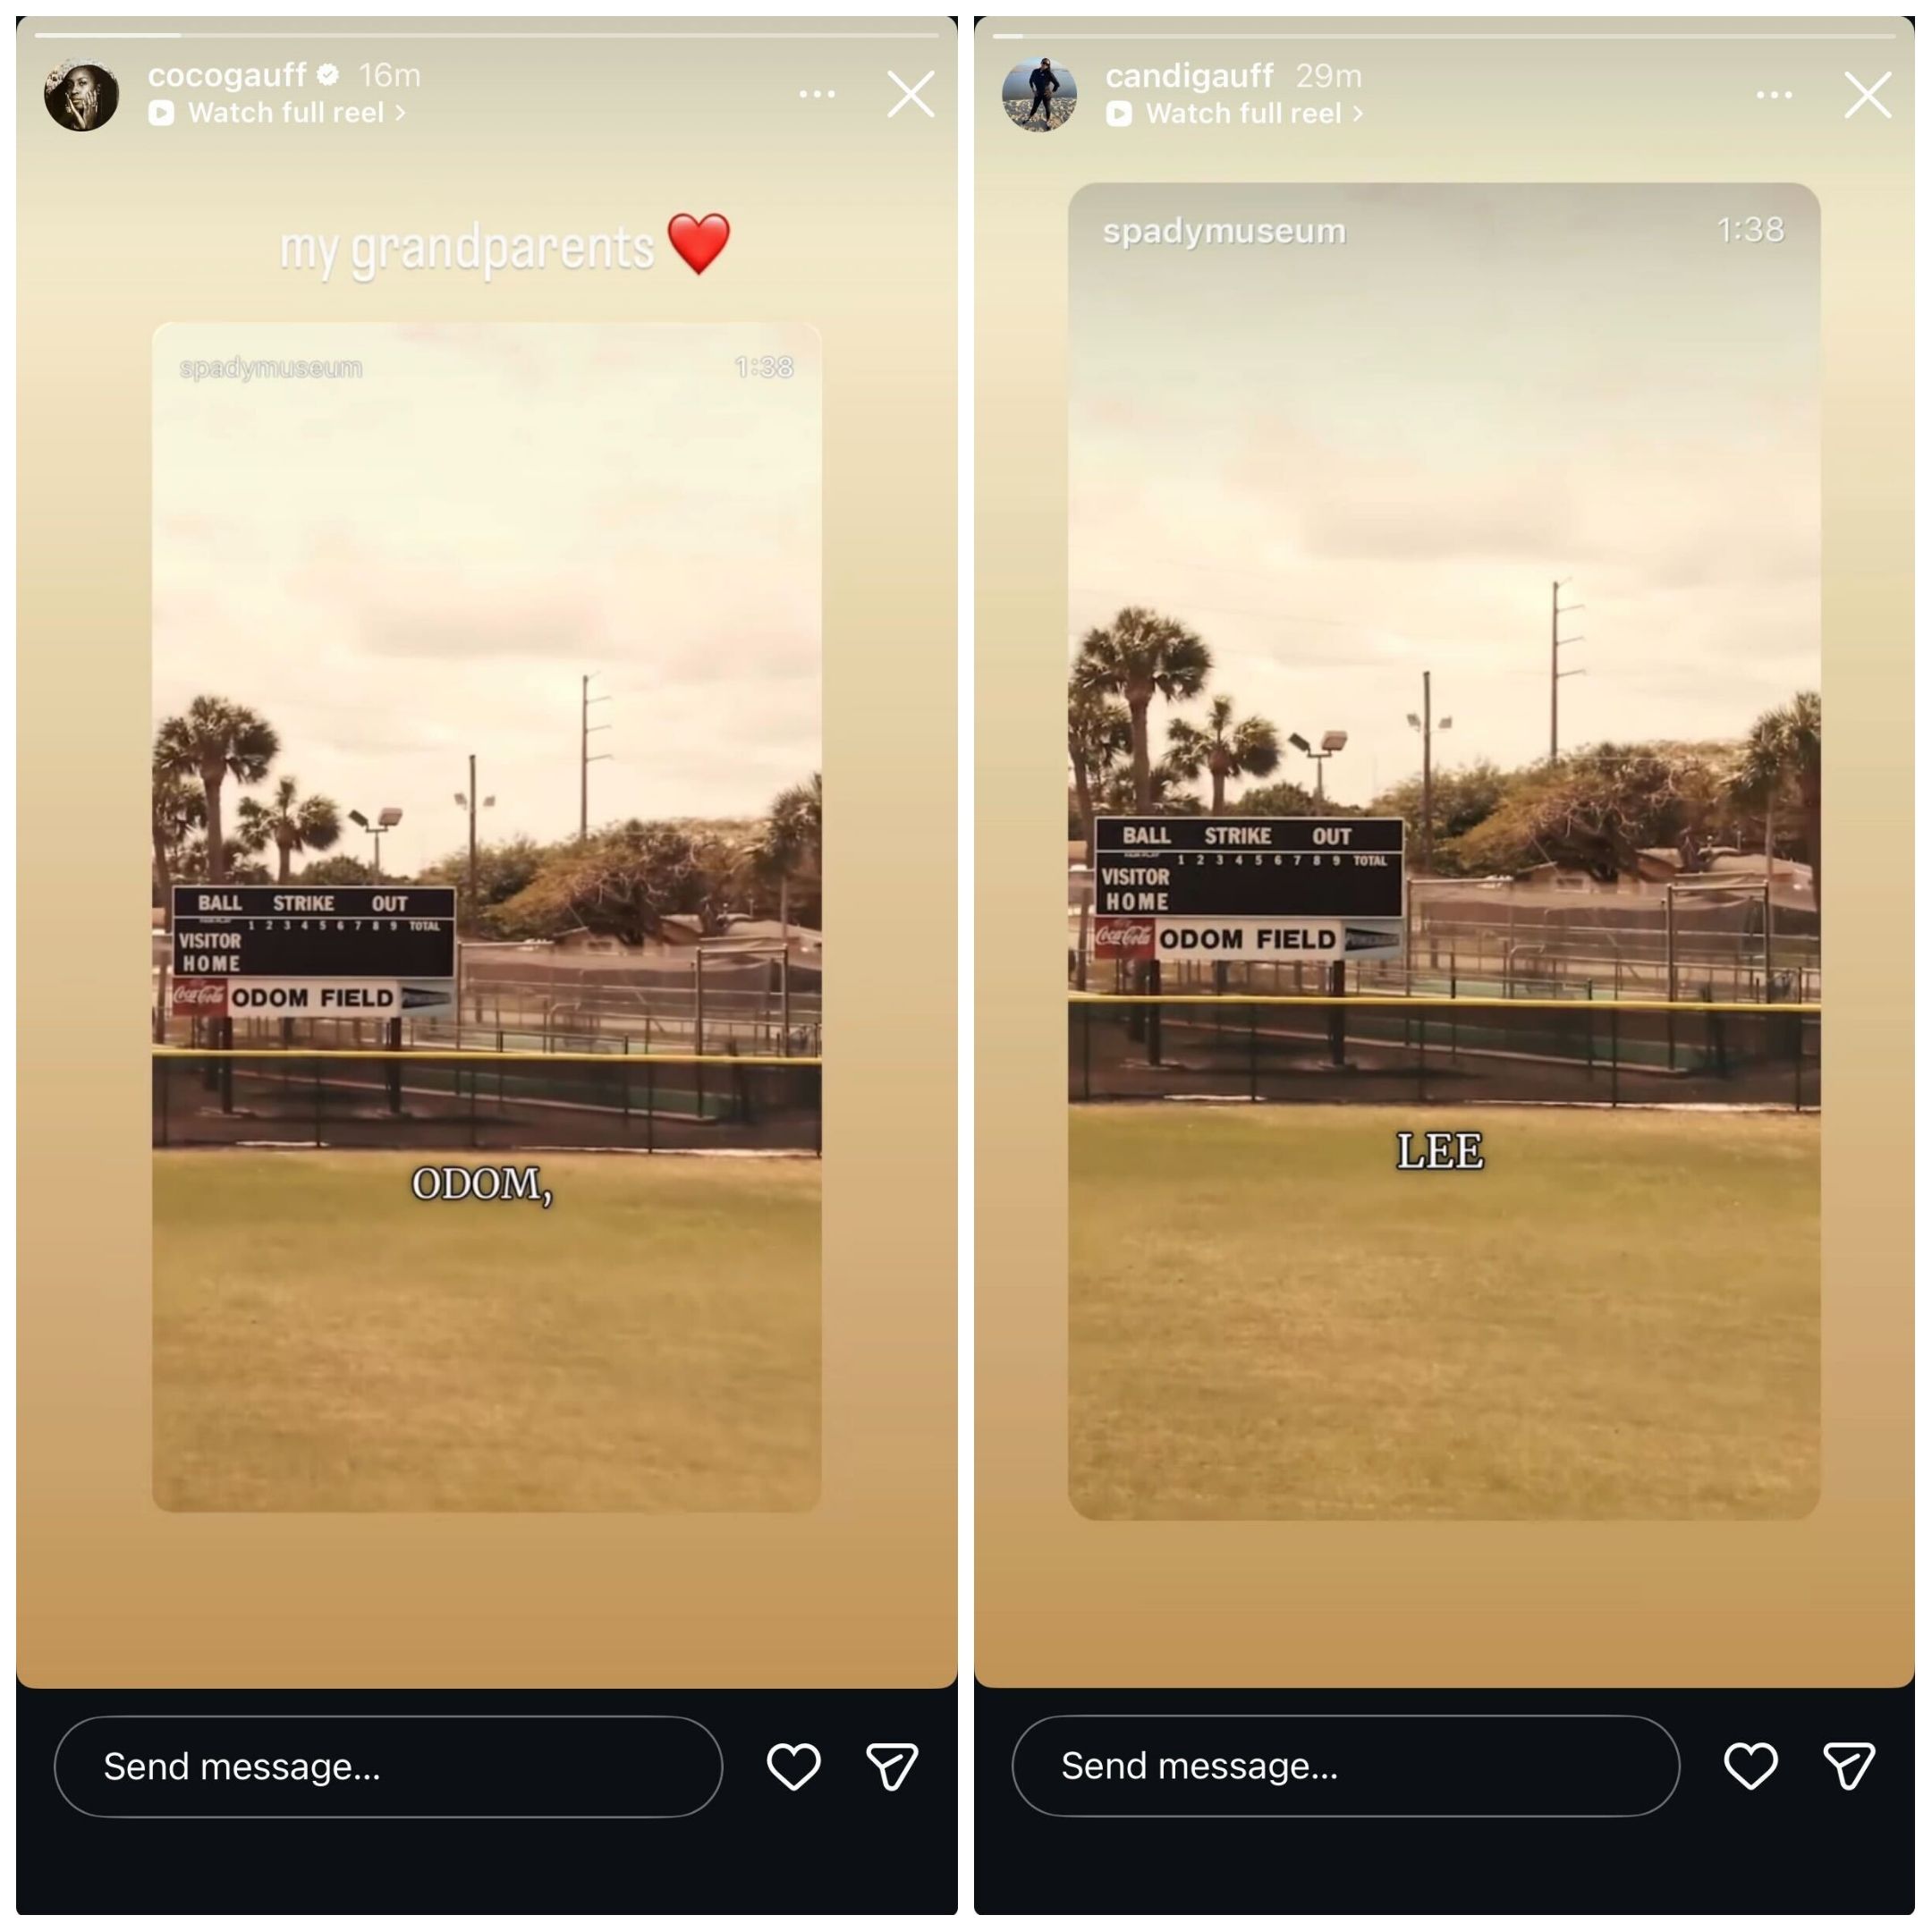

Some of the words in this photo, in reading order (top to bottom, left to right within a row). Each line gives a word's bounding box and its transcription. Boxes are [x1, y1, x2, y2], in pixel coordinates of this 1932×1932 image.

[1123, 826, 1172, 844] BALL
[1205, 826, 1272, 845] STRIKE
[1312, 826, 1352, 845] OUT
[1178, 855, 1184, 866] 1
[1197, 855, 1205, 866] 2
[1216, 855, 1224, 866] 3
[1234, 855, 1243, 865] 4
[1255, 855, 1263, 866] 5
[1274, 855, 1283, 866] 6
[1293, 855, 1301, 866] 7
[1313, 855, 1321, 867] 8
[1332, 855, 1341, 867] 9
[1353, 855, 1388, 867] TOTAL
[1101, 868, 1170, 886] VISITOR
[198, 894, 243, 911] BALL
[273, 894, 335, 911] STRIKE
[371, 894, 409, 912] OUT
[1106, 892, 1169, 911] HOME
[249, 920, 255, 931] 1
[266, 919, 274, 930] 2
[284, 919, 292, 931] 3
[301, 920, 309, 930] 4
[319, 919, 326, 931] 5
[336, 920, 344, 931] 6
[354, 919, 362, 931] 7
[372, 920, 379, 931] 8
[390, 920, 398, 931] 9
[409, 919, 441, 932] TOTAL
[179, 932, 242, 949] VISITOR
[1159, 928, 1243, 950] ODOM
[1257, 928, 1336, 950] FIELD
[183, 954, 241, 972] HOME
[231, 987, 309, 1008] ODOM
[320, 988, 394, 1008] FIELD
